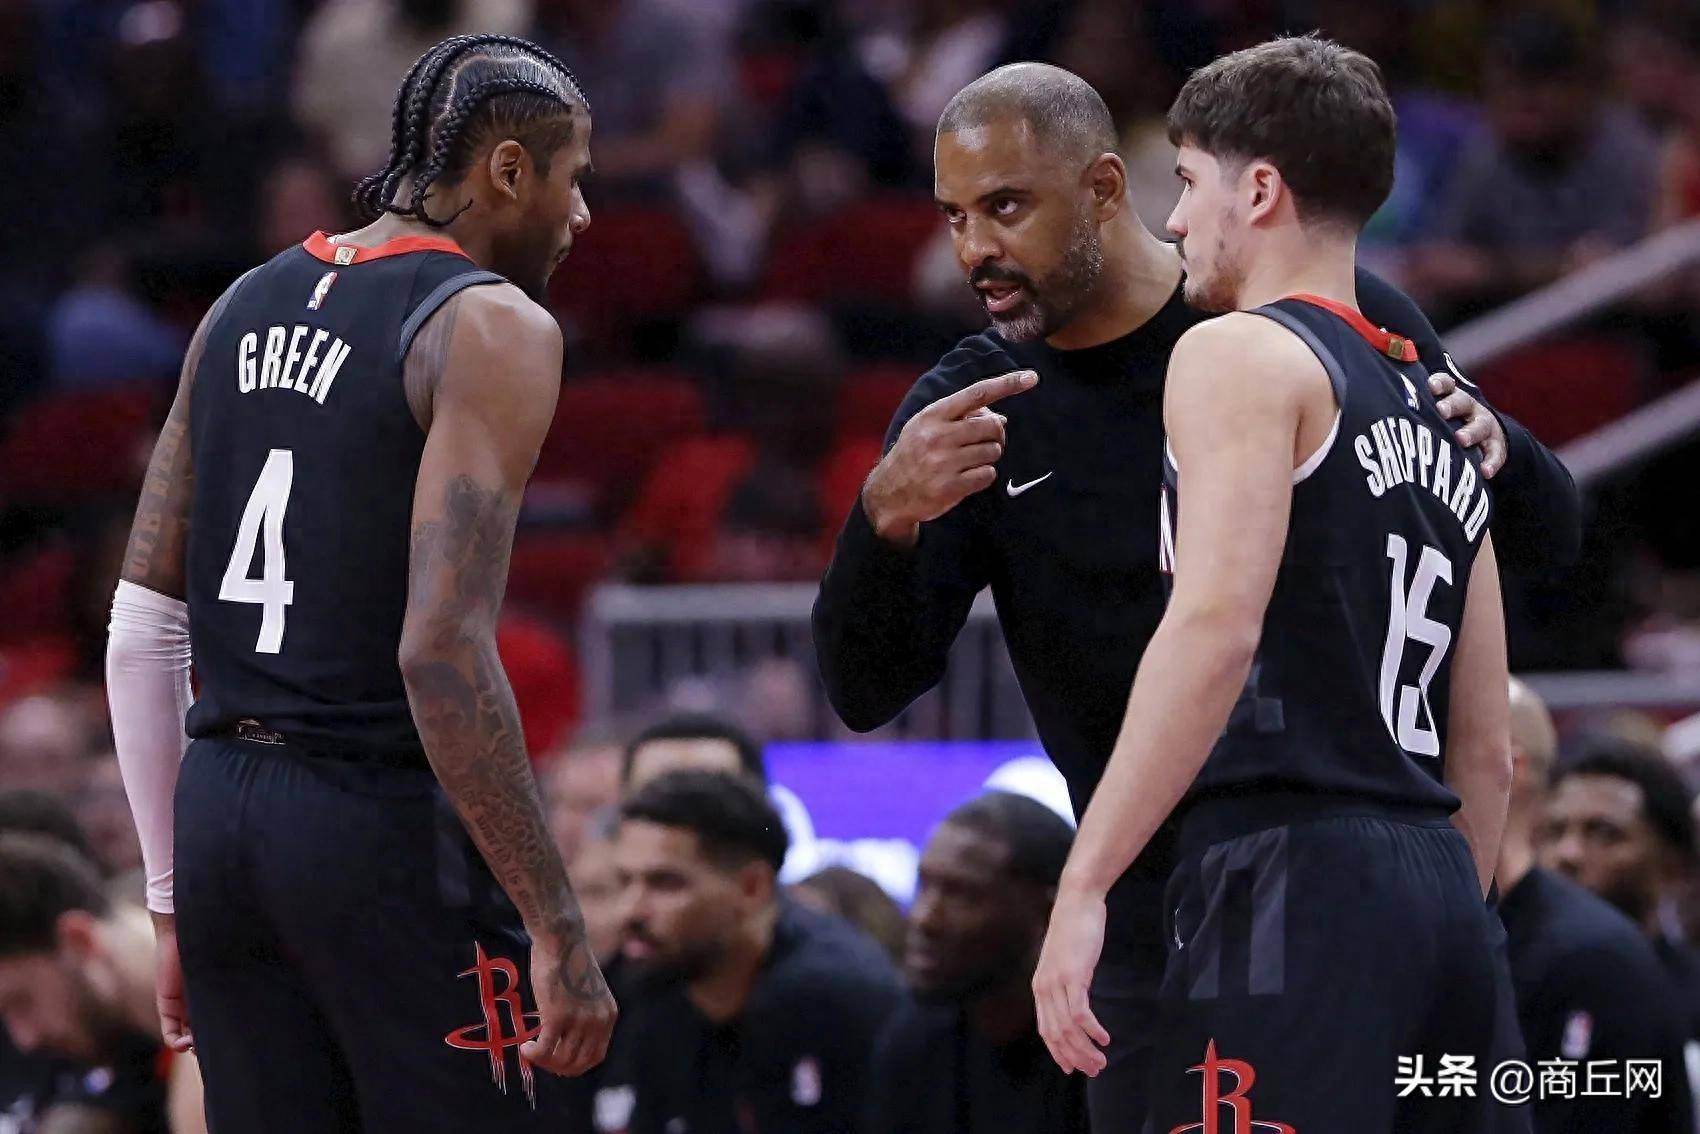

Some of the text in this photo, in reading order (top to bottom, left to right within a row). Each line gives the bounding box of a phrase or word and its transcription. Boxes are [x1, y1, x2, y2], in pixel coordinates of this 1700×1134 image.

[238, 324, 352, 405] GREEN
[217, 448, 295, 654] 4
[1354, 416, 1491, 543] SHEPPARD
[1378, 532, 1453, 757] 15
